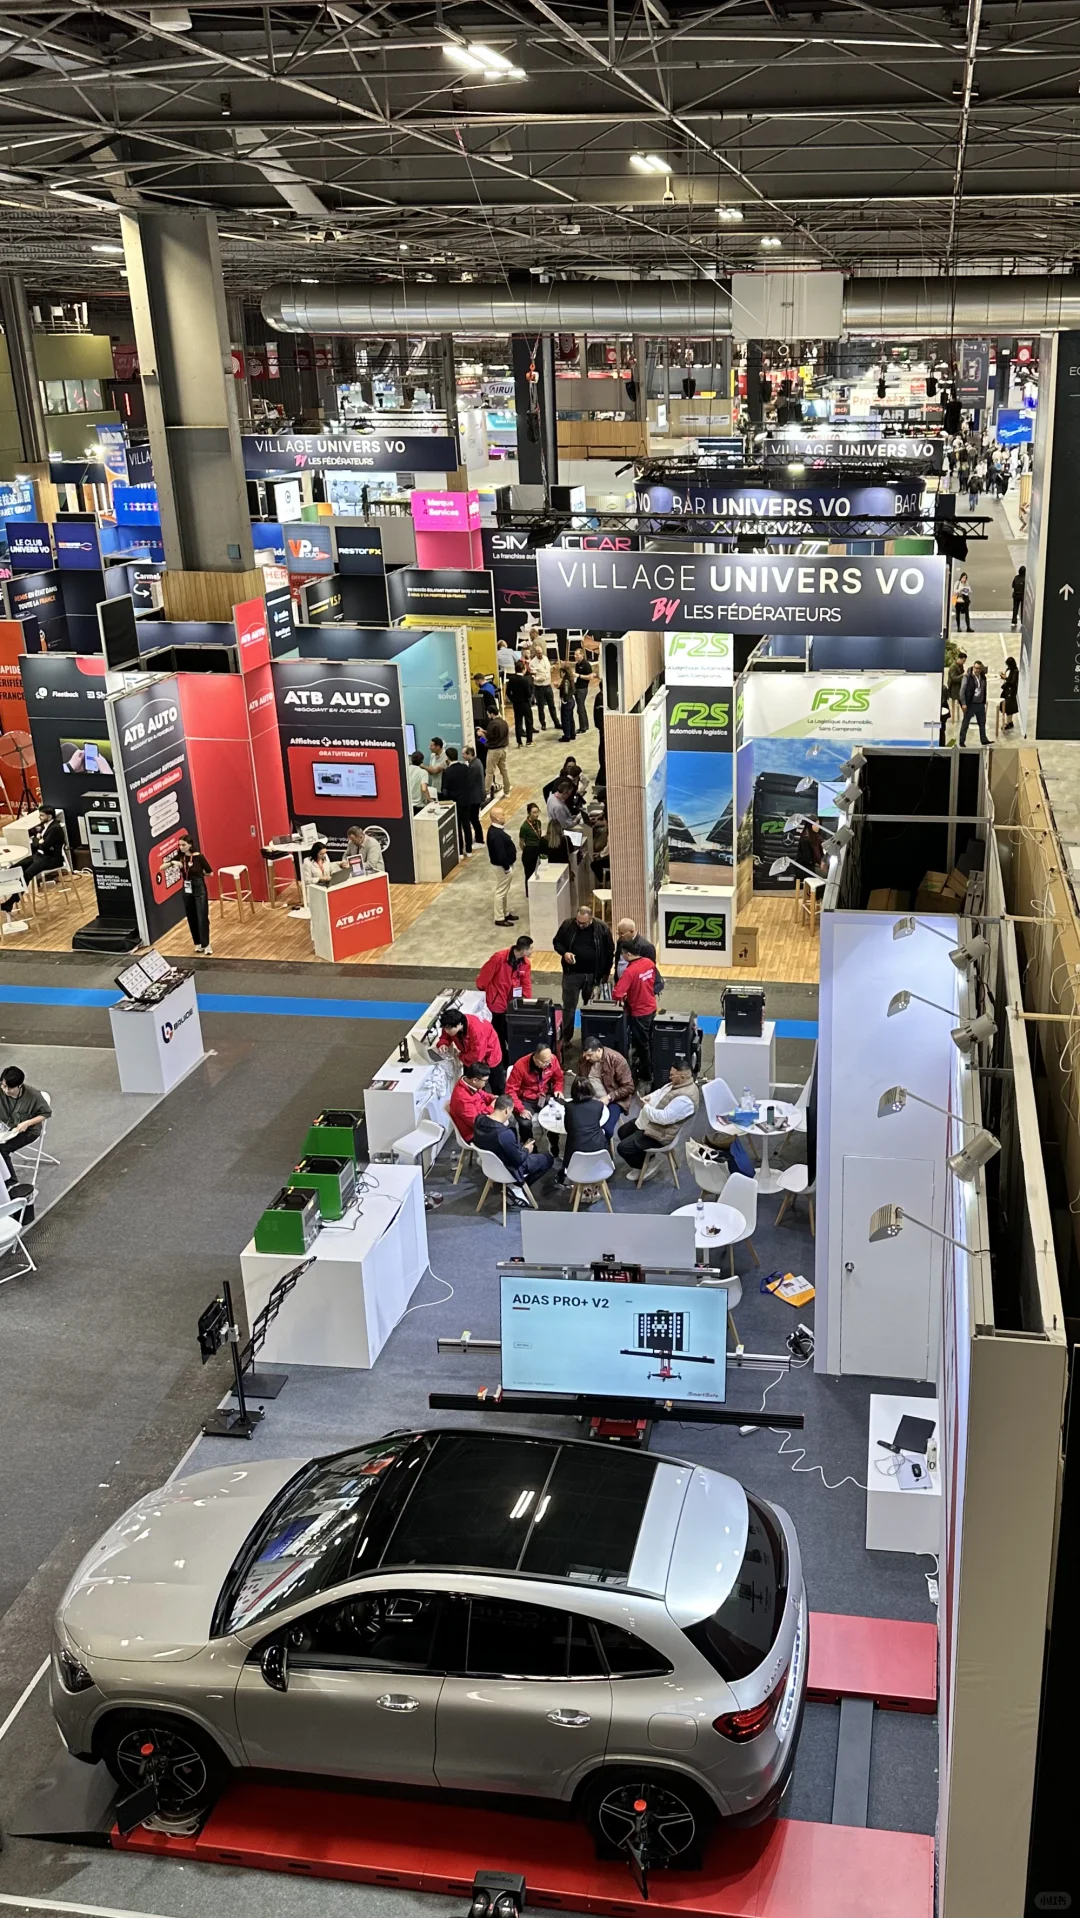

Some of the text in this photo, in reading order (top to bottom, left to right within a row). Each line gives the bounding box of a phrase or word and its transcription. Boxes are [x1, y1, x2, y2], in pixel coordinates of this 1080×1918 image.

[255, 440, 406, 453] VILLAGE UNIVERS VO
[771, 443, 934, 457] VILLAGE UNIVERS VO
[129, 451, 152, 466] VILLA
[322, 456, 374, 466] FÉDÉRATEURS
[639, 492, 651, 513] VO
[672, 496, 851, 517] BAR UNIVERS VO
[894, 494, 916, 515] BAR
[428, 508, 459, 516] Services
[10, 546, 50, 554] UNIVERS VO
[25, 539, 42, 547] CLUB
[287, 539, 311, 558] VP
[501, 552, 526, 560] franchise
[557, 561, 924, 595] VILLAGE UNIVERS VO
[650, 597, 842, 624] BY LES FÉDÉRATEURS
[668, 632, 729, 657] F2S
[0, 692, 25, 701] FRANCE
[259, 692, 273, 706] AUTO
[283, 690, 391, 707] ATB AUTO
[437, 692, 458, 700] solvd
[811, 688, 872, 712] F2S
[669, 702, 730, 728] F2S
[124, 706, 178, 746] ATB AUTO
[669, 728, 728, 737] automotive logistics
[290, 737, 320, 746] Affichez
[360, 738, 396, 748] véhicules
[318, 750, 364, 758] GRATUITEMENT
[335, 915, 354, 928] ATB
[356, 906, 384, 921] AUTO
[667, 915, 723, 939] F2S
[512, 1293, 609, 1309] ADAS PRO+ V2
[687, 1391, 719, 1399] SmartSafe
